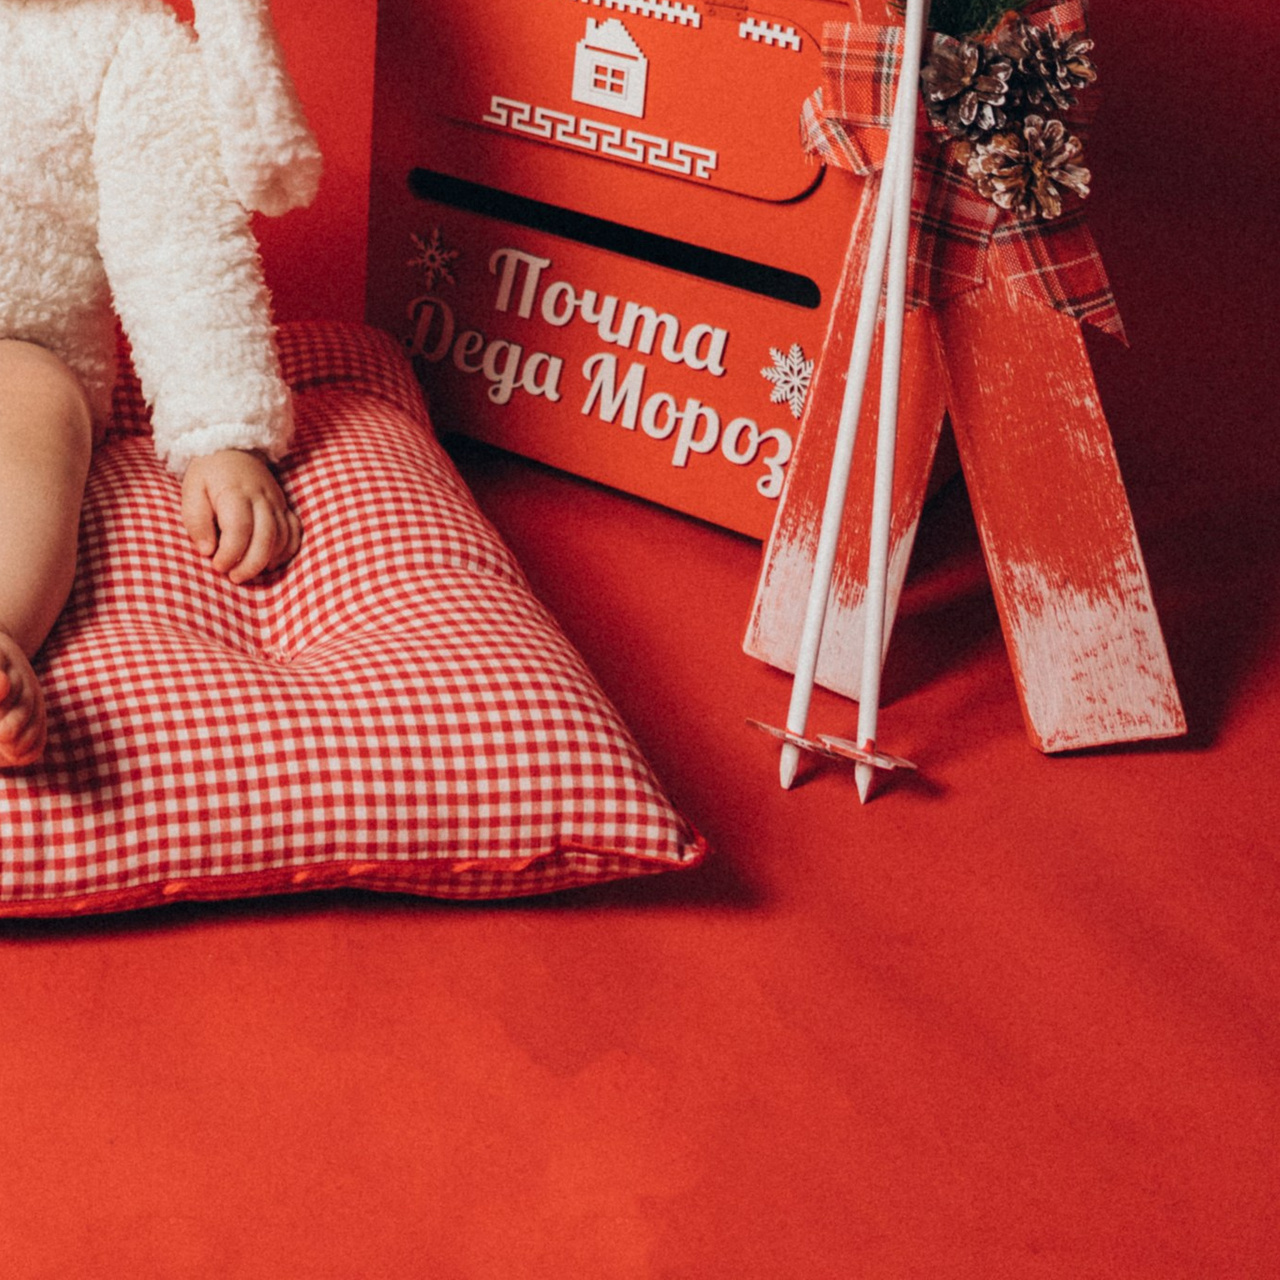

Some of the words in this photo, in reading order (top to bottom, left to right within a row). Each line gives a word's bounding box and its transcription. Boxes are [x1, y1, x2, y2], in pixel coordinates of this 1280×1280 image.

[489, 248, 730, 376] Почта
[406, 297, 563, 405] Деда
[581, 353, 793, 499] Мороз
